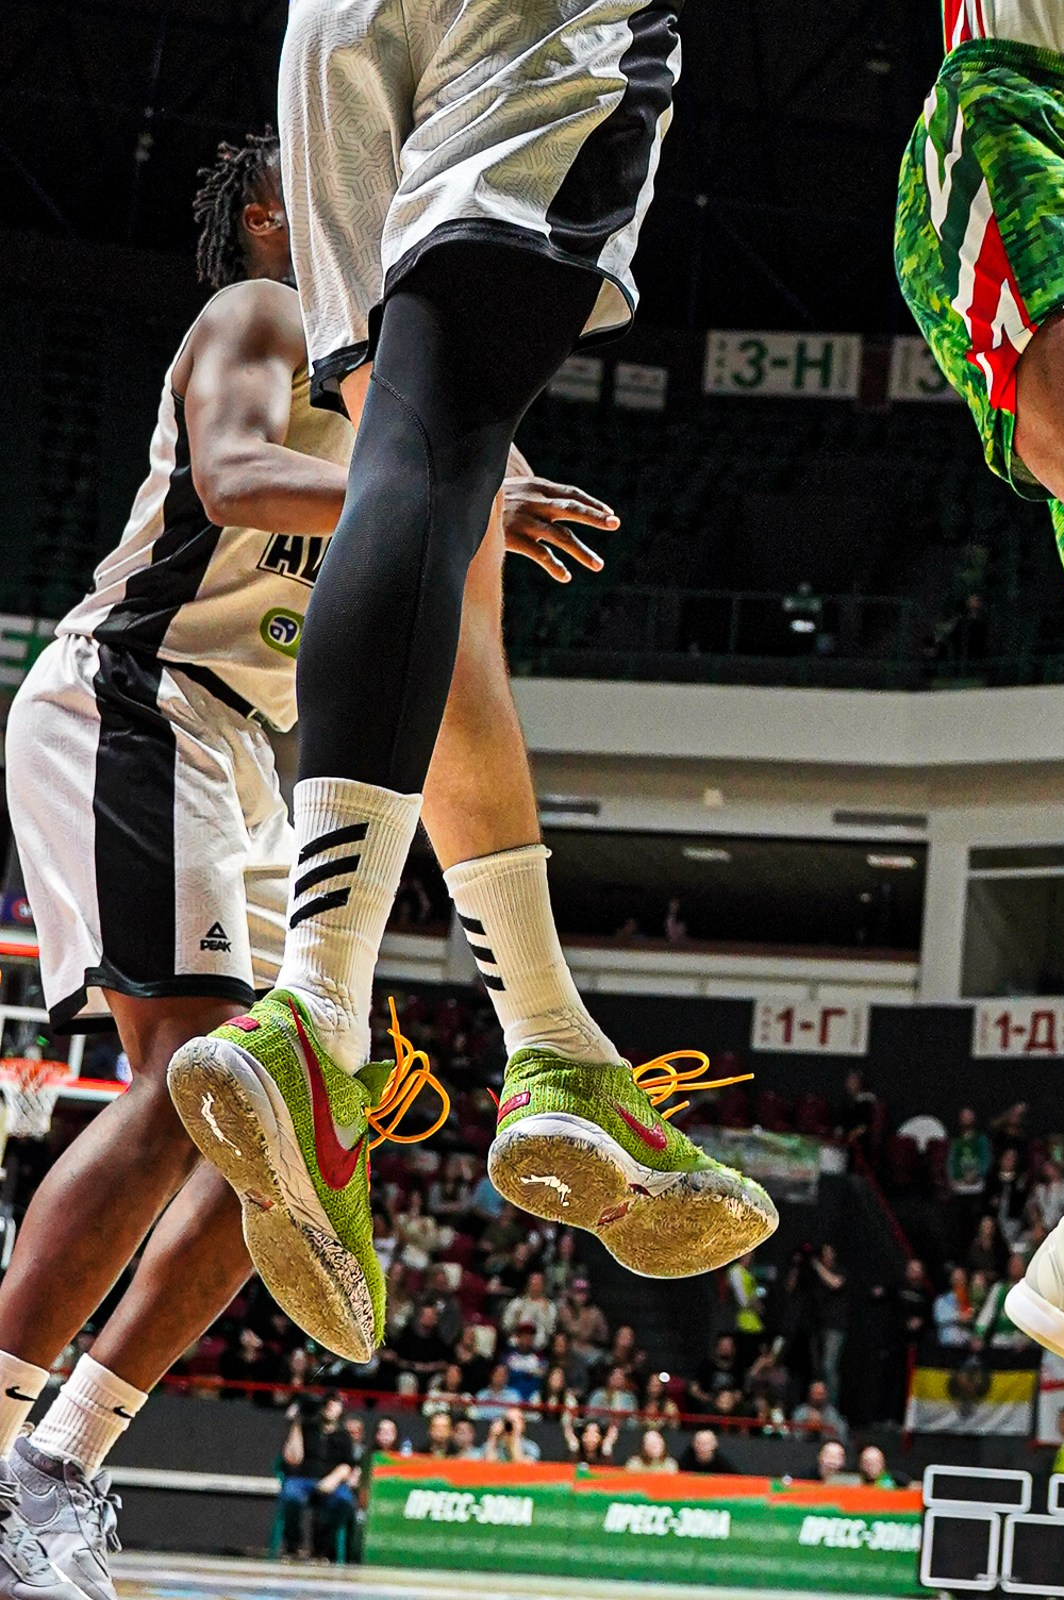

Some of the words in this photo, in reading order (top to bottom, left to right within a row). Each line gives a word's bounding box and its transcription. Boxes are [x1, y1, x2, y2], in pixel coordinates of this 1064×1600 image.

[200, 939, 232, 953] PEAK
[777, 1006, 847, 1046] 1-Г
[995, 1009, 1057, 1054] 1-Д
